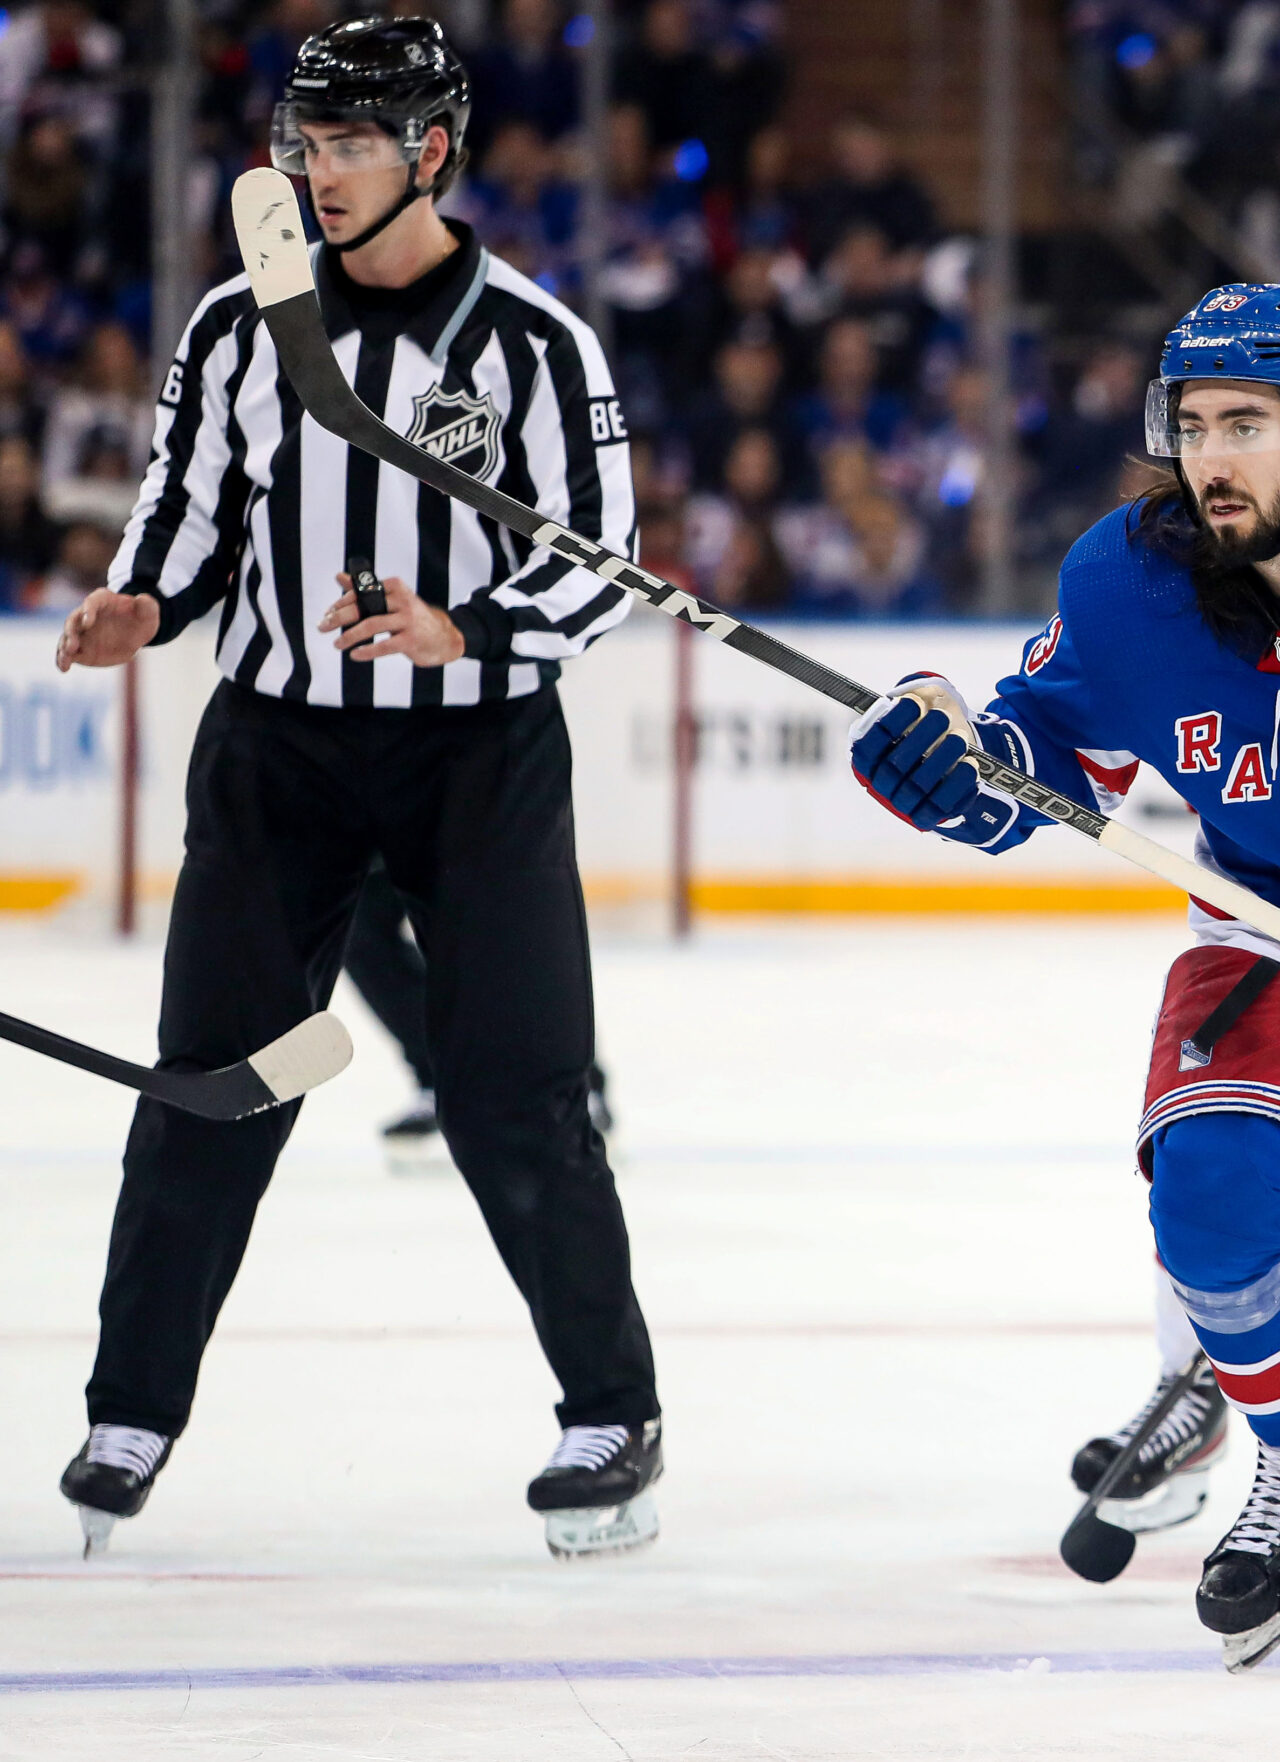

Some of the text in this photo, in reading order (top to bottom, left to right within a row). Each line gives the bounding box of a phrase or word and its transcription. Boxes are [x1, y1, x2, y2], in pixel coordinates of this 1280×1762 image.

[1203, 294, 1248, 312] 93
[425, 418, 486, 457] NHL
[531, 521, 742, 642] CCM
[1024, 612, 1064, 678] 3
